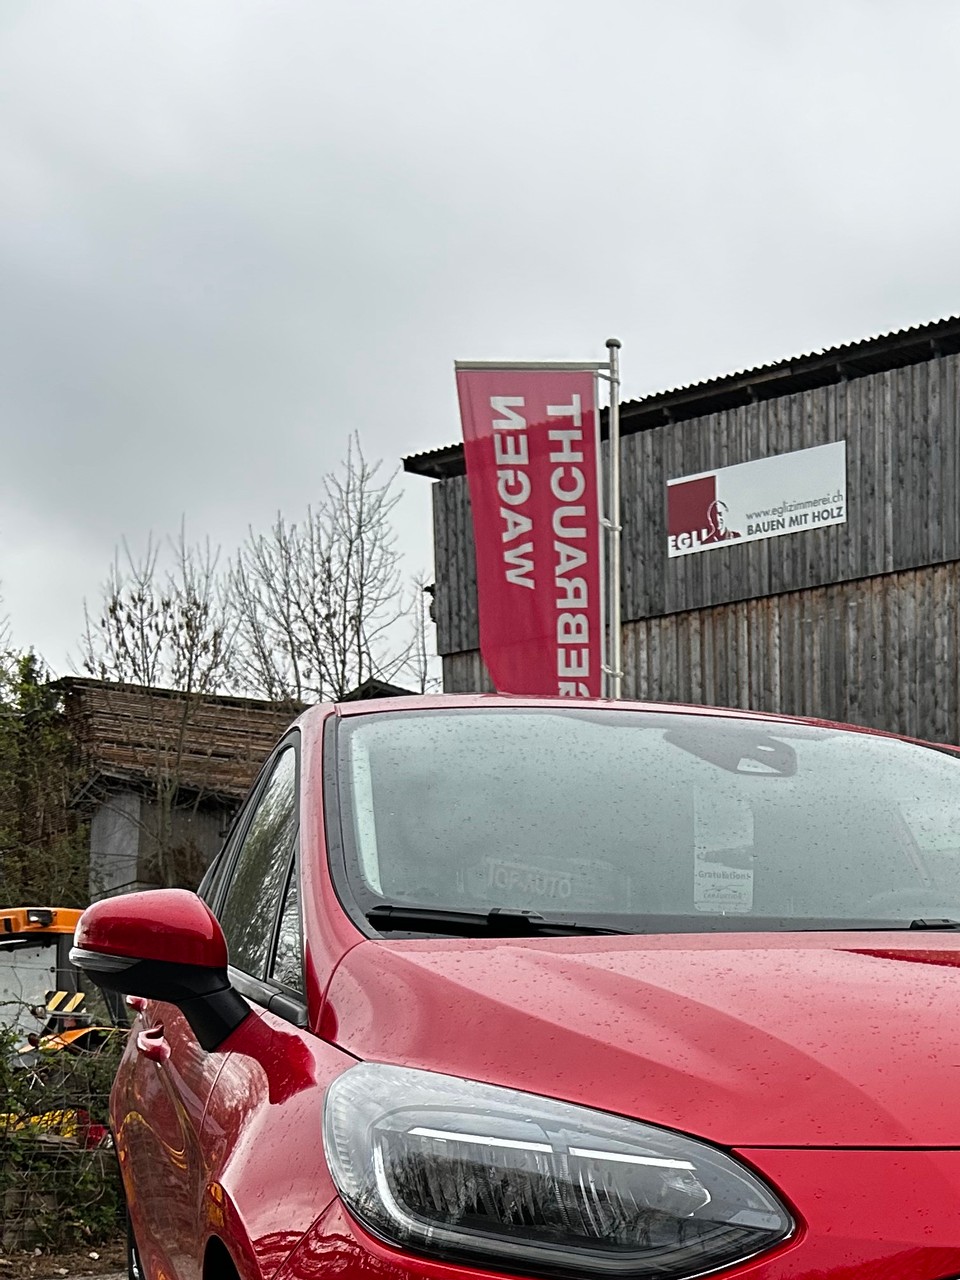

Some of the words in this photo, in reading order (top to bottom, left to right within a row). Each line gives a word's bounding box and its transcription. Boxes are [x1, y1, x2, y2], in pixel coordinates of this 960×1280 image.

[745, 489, 844, 520] www.eglizimmerei.ch
[746, 518, 786, 536] BAUEN
[788, 513, 809, 528] MIT
[812, 506, 843, 523] HOLZ
[667, 528, 708, 551] EGLI
